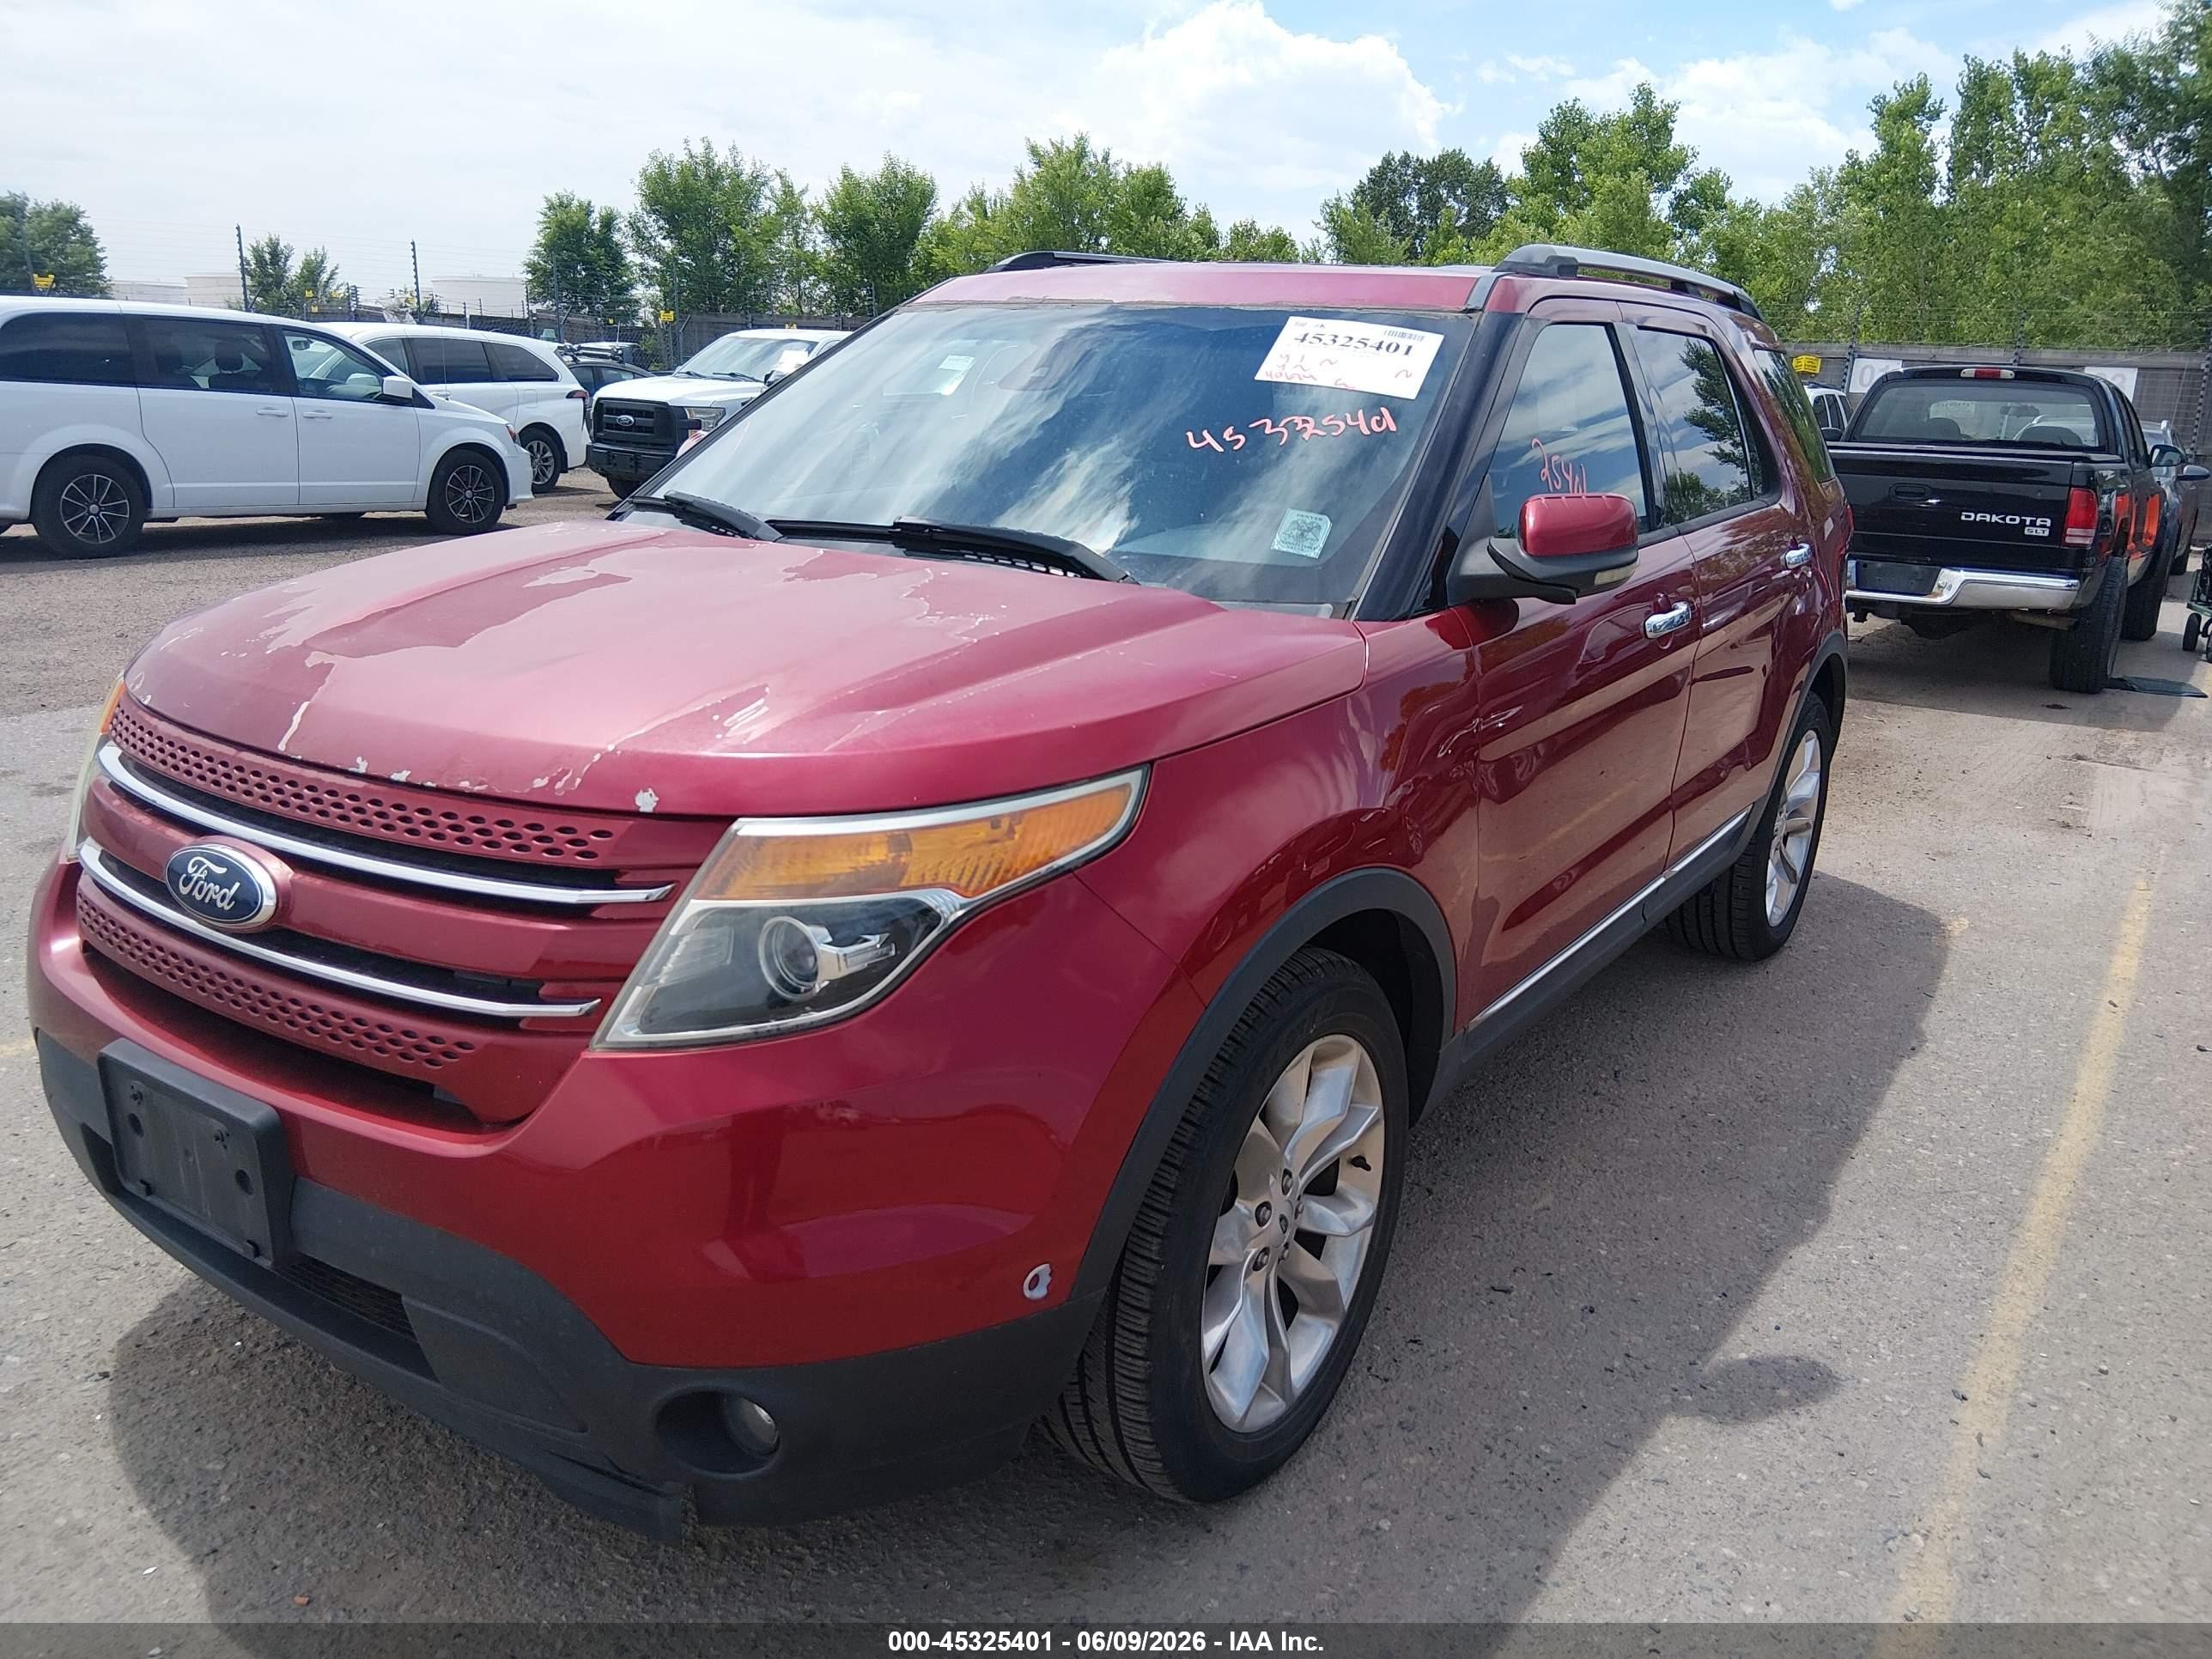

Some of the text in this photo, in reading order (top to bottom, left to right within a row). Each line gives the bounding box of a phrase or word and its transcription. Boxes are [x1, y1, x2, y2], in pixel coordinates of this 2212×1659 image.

[1294, 332, 1414, 356] 45325401
[1960, 511, 2051, 527] DAKOTA
[2026, 527, 2049, 536] SLT
[179, 856, 241, 910] Ford
